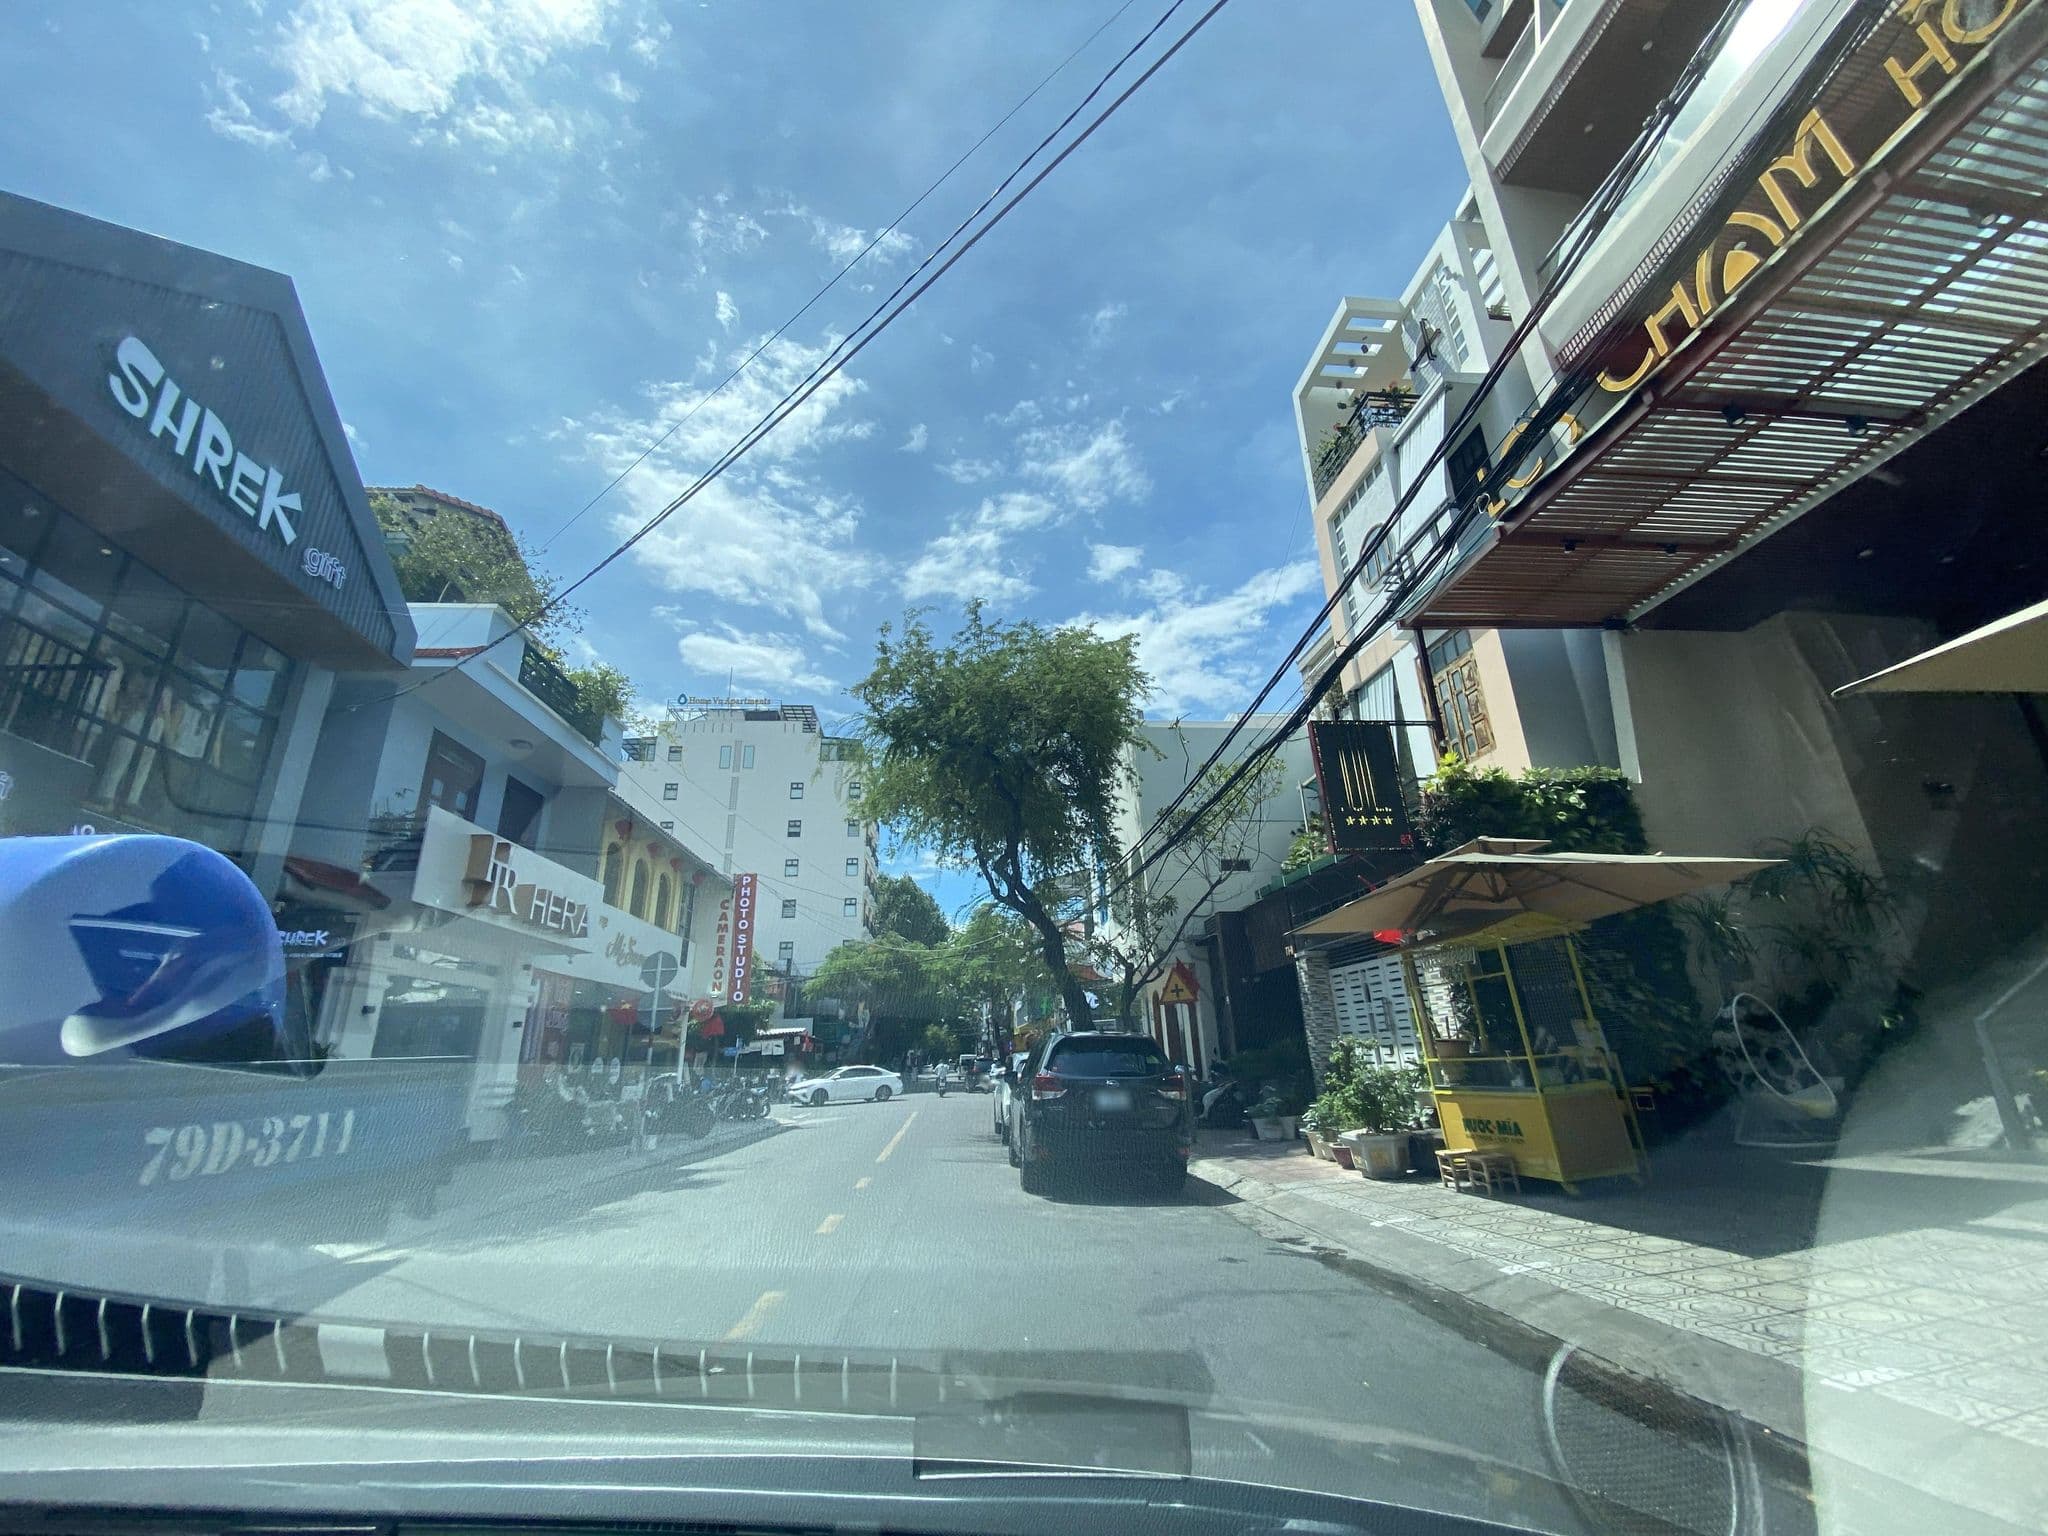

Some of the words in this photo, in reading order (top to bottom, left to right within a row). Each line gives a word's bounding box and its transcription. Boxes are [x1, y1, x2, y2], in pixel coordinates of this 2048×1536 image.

[109, 336, 303, 546] SHREK
[303, 546, 348, 590] gift
[688, 696, 711, 705] Home
[724, 696, 771, 706] Apartments
[737, 876, 752, 930] PHOTO
[733, 934, 748, 1002] STUDIO
